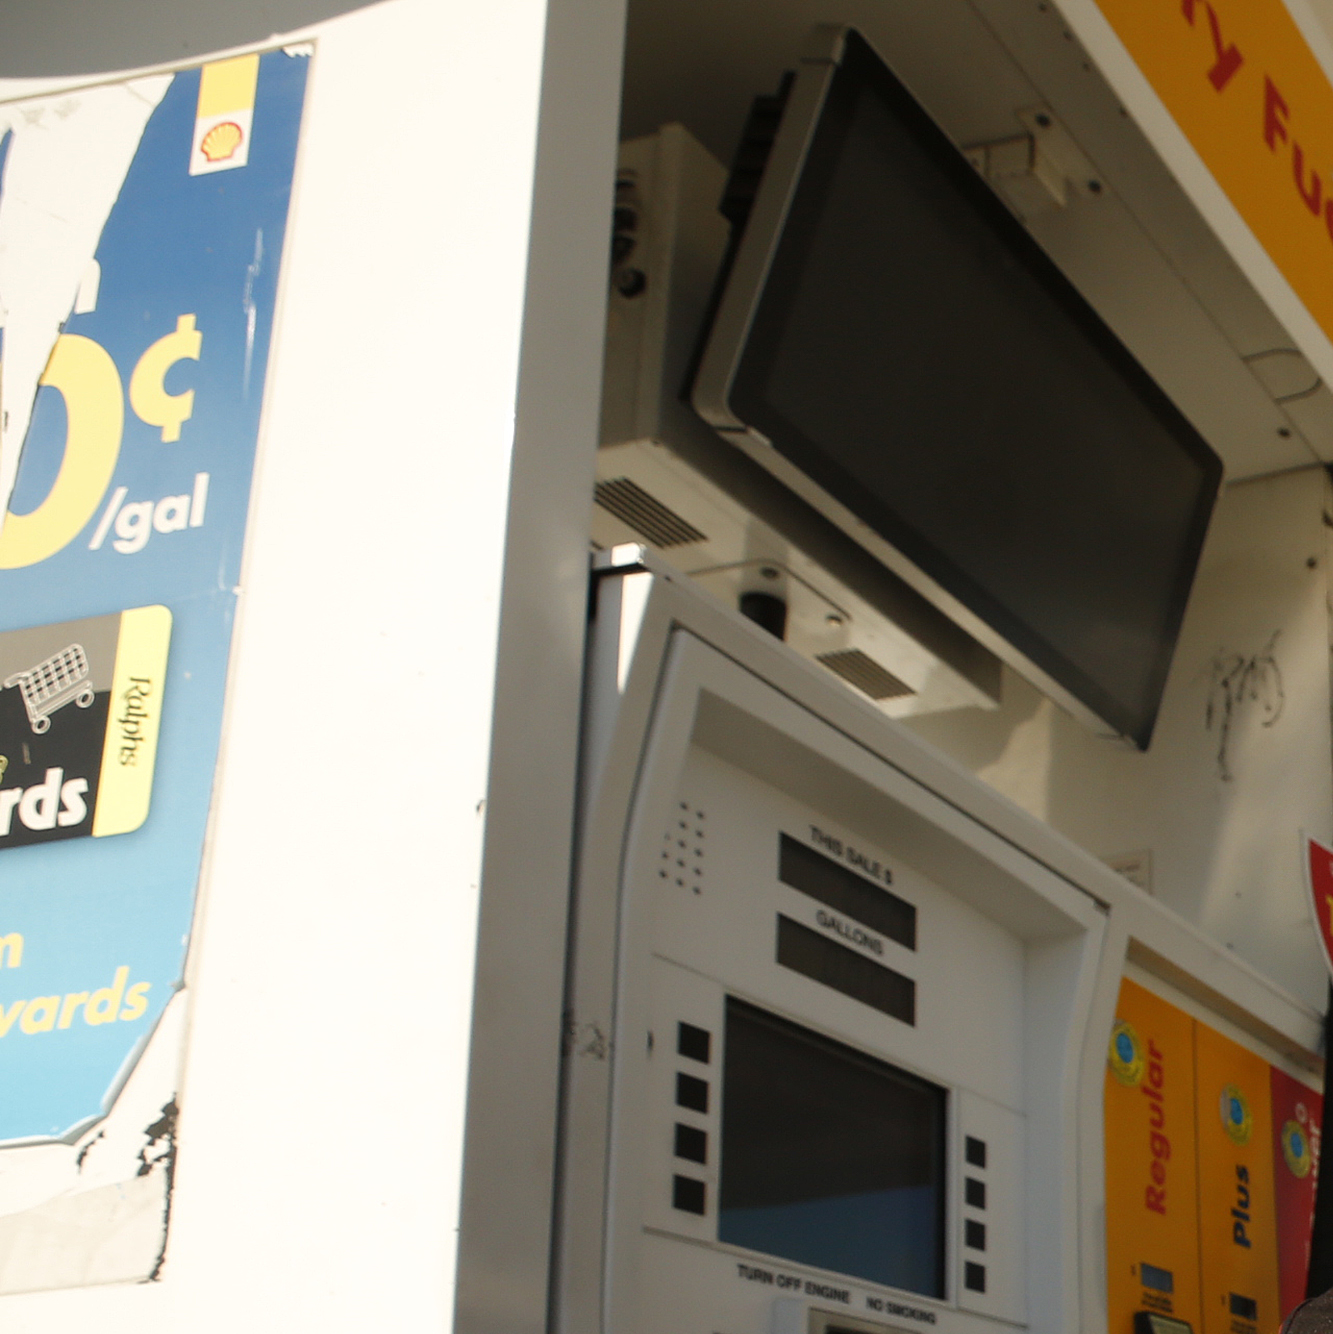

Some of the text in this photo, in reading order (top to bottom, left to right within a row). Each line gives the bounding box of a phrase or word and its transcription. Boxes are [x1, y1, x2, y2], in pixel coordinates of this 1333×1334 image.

[89, 472, 210, 553] /gal
[117, 676, 152, 766] Ralphs
[809, 824, 843, 858] THIS
[846, 847, 882, 880] SALE
[816, 909, 884, 956] GALLONS
[1141, 1038, 1171, 1217] Regular
[1230, 1163, 1252, 1249] Plus
[737, 1263, 937, 1326] TURN OFF ENGINE NO SMOKING
